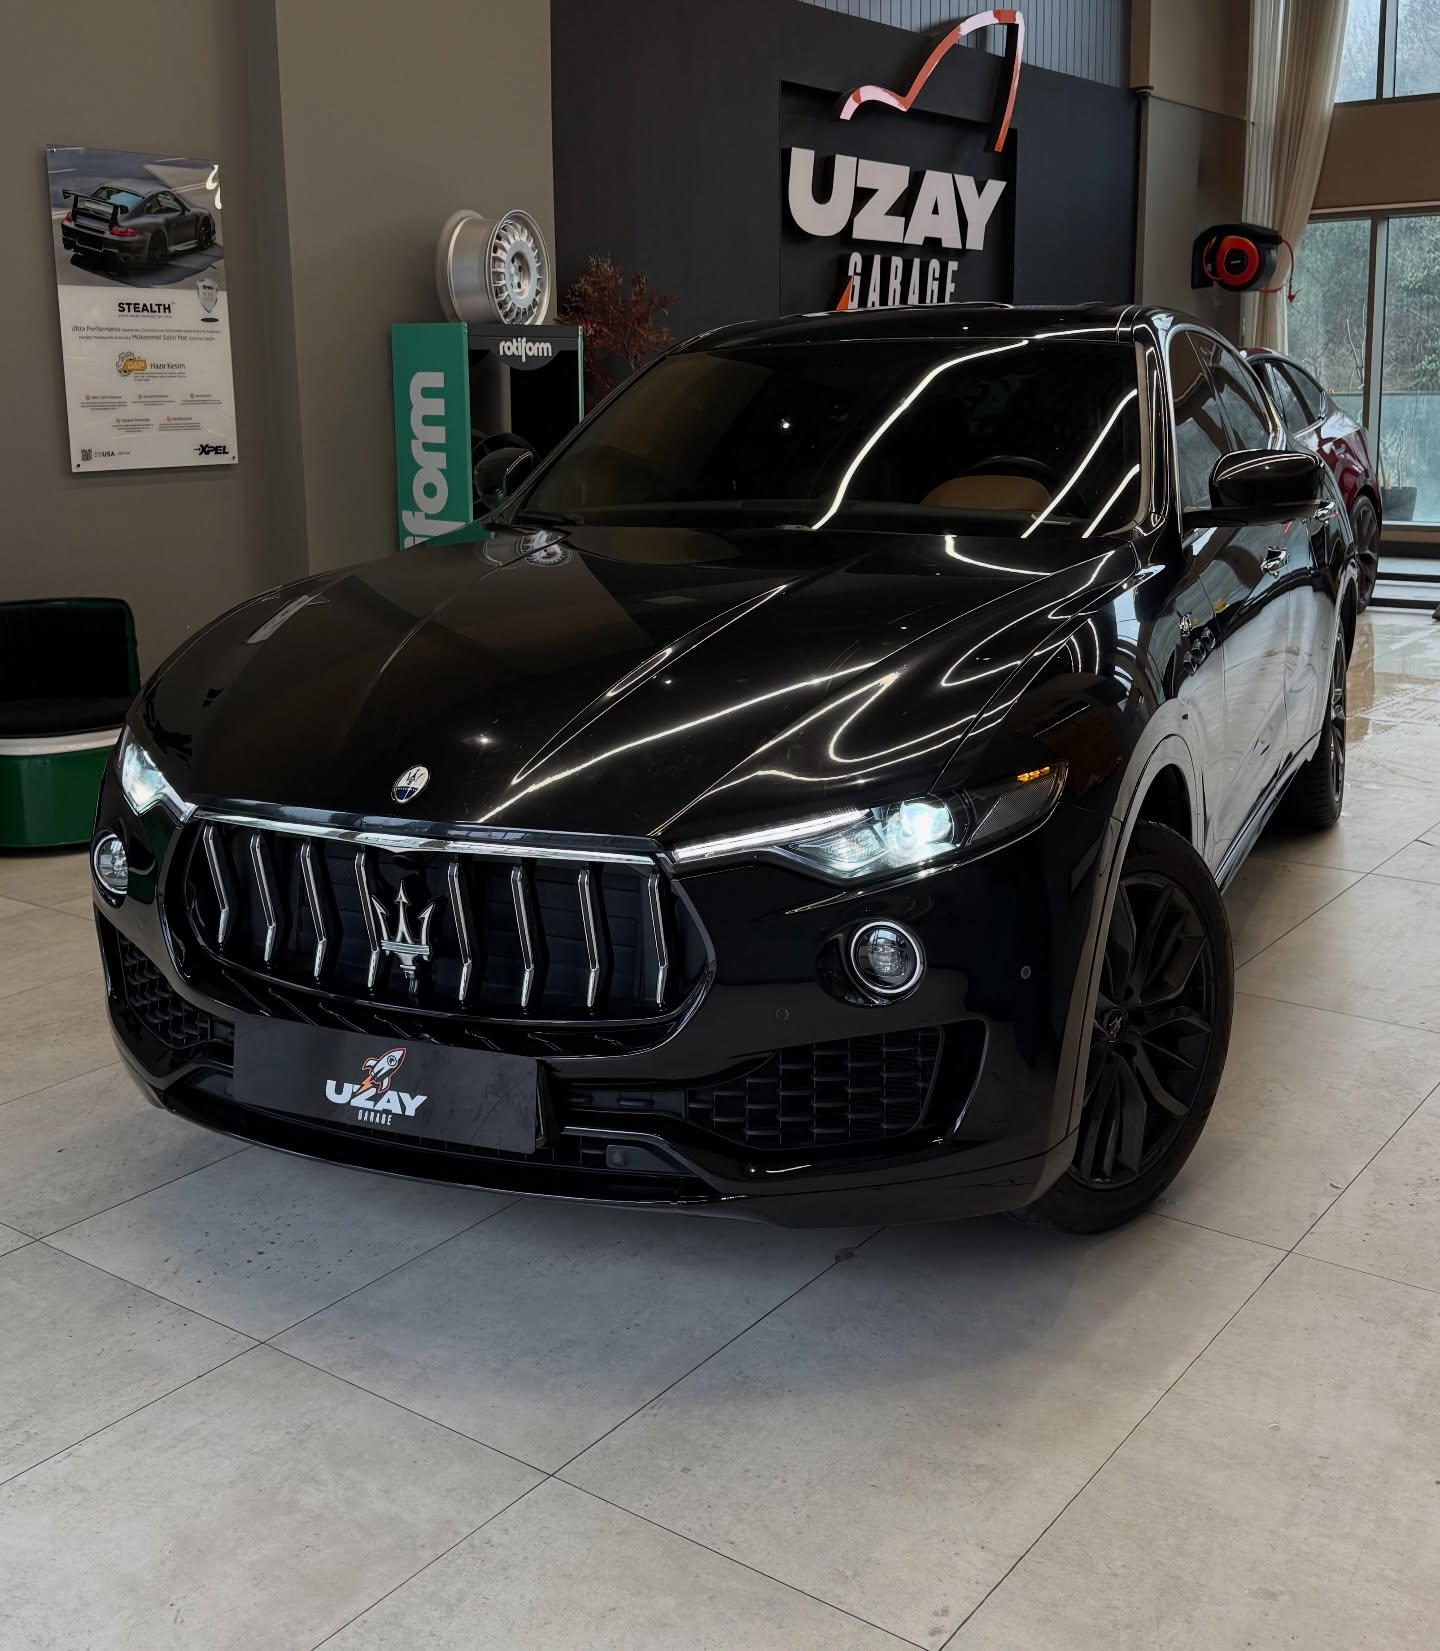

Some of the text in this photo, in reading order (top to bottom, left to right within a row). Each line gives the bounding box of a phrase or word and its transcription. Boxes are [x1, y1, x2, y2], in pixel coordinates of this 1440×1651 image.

[788, 146, 1007, 250] UZAY
[847, 251, 959, 309] GARAGE
[118, 302, 172, 314] STEALTH
[499, 337, 552, 362] rotiform
[167, 362, 186, 370] Kesim
[197, 444, 229, 456] XPEL
[325, 1079, 428, 1117] UZAY
[357, 1109, 393, 1126] GARAGE
